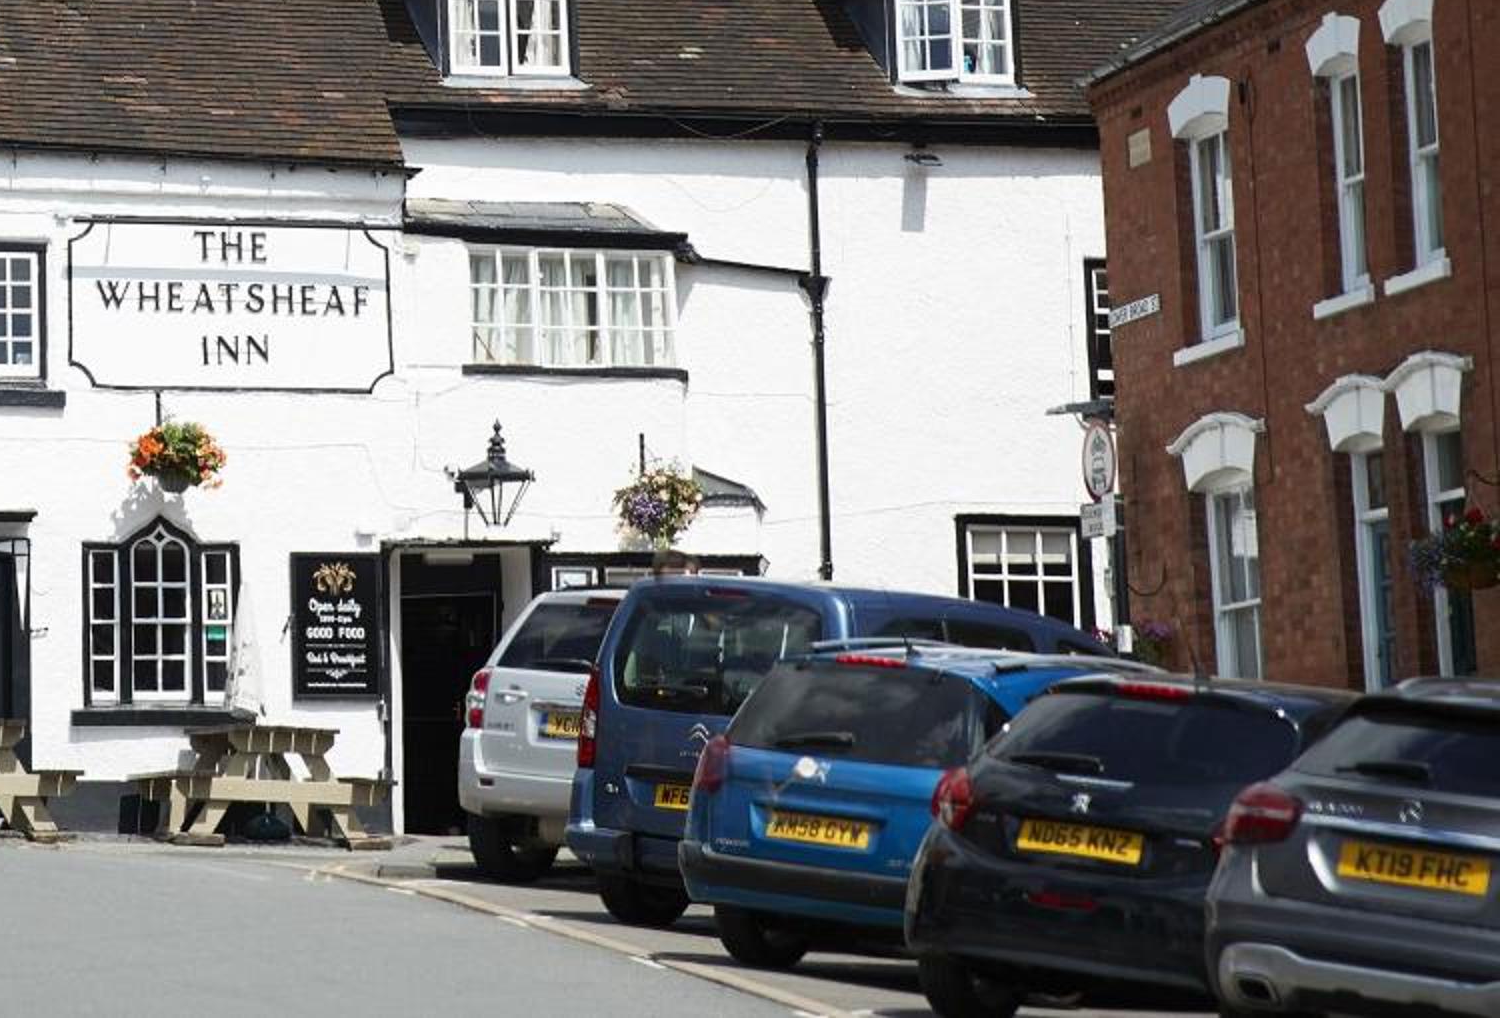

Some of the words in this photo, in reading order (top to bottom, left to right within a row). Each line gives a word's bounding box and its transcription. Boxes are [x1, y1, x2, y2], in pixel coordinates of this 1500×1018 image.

[194, 231, 268, 263] THE
[96, 280, 370, 317] WHEATSHEAF
[202, 335, 269, 365] INN
[308, 597, 335, 617] Open
[337, 598, 362, 619] daily
[306, 627, 333, 639] GOOD
[338, 627, 365, 639] FOOD
[662, 786, 689, 805] WF6
[1355, 843, 1413, 877] KT19
[1418, 855, 1472, 887] FHC
